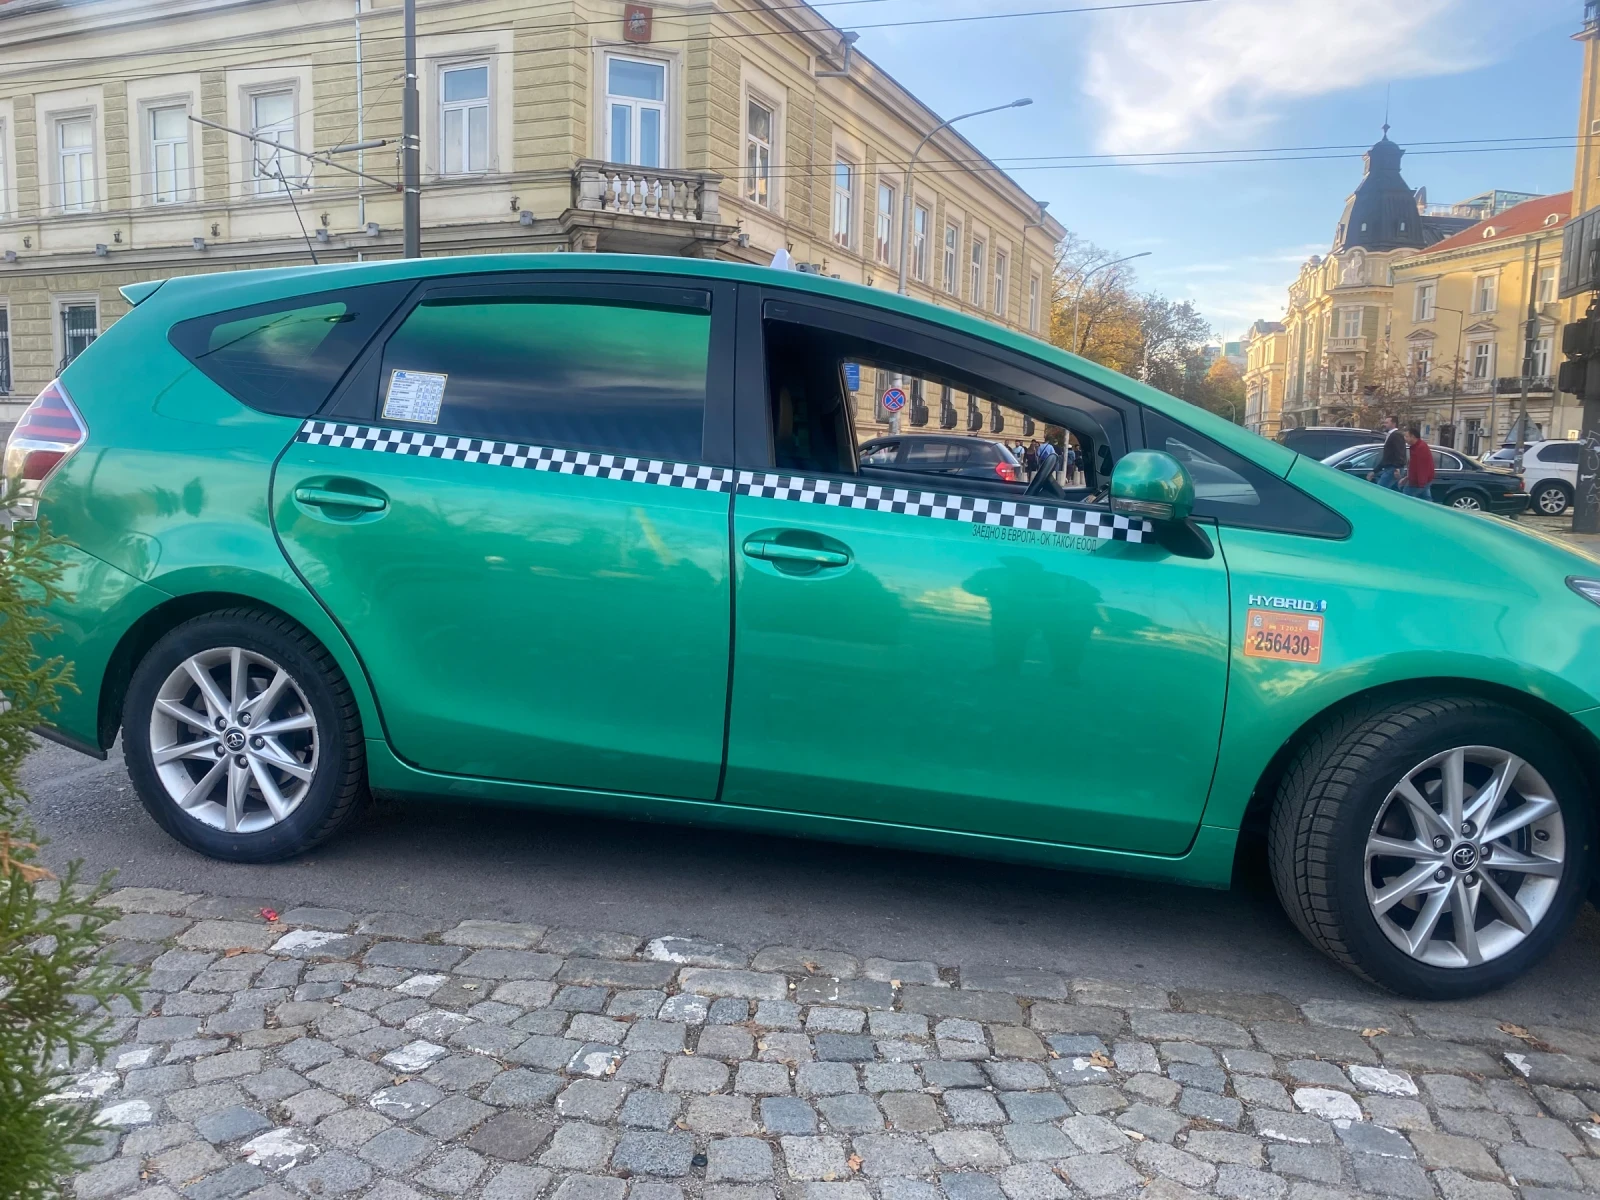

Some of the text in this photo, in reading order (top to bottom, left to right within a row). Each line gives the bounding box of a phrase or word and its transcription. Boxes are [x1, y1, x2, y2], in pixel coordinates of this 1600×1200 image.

[972, 524, 1000, 540] ЗАЕДНО
[1001, 528, 1006, 540] В
[1007, 528, 1036, 544] ЕВРОПА
[1040, 532, 1050, 546] ОК
[1052, 534, 1075, 549] ТАКСИ
[1076, 537, 1097, 553] ЕООД
[1248, 594, 1314, 611] HYBRID
[1255, 631, 1310, 656] 256430
